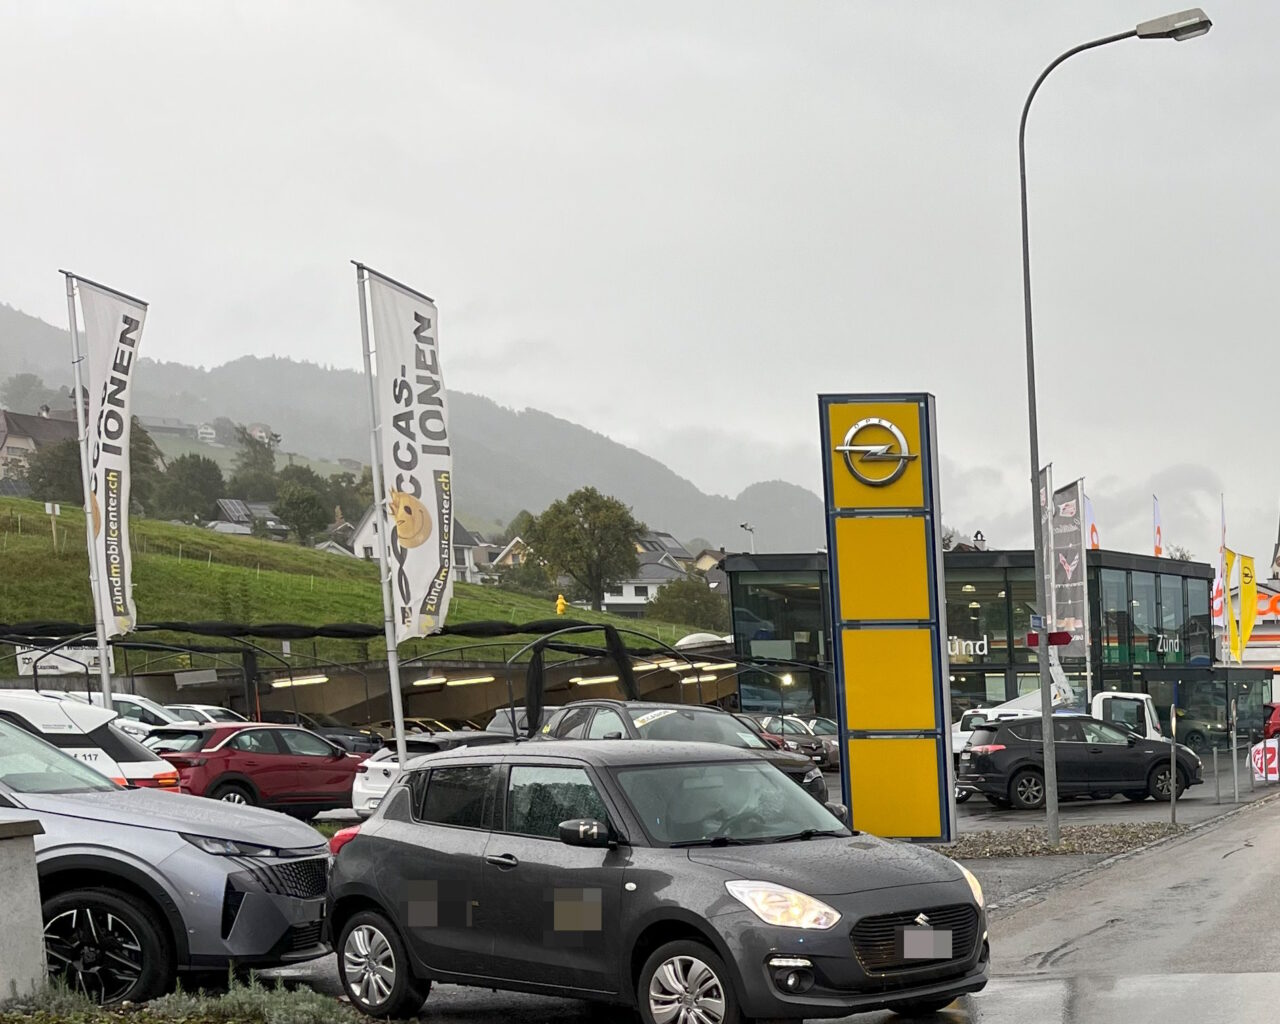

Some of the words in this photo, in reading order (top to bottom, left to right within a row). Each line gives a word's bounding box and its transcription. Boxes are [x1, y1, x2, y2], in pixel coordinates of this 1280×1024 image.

[102, 314, 140, 456] IONEN
[413, 310, 450, 457] IONEN
[854, 418, 894, 430] OPEL
[106, 471, 125, 613] zündmobilcenter.ch
[424, 472, 451, 615] zündmobilcenter.ch
[947, 634, 988, 656] ünd
[1157, 633, 1180, 653] Zünd
[82, 753, 98, 761] 117
